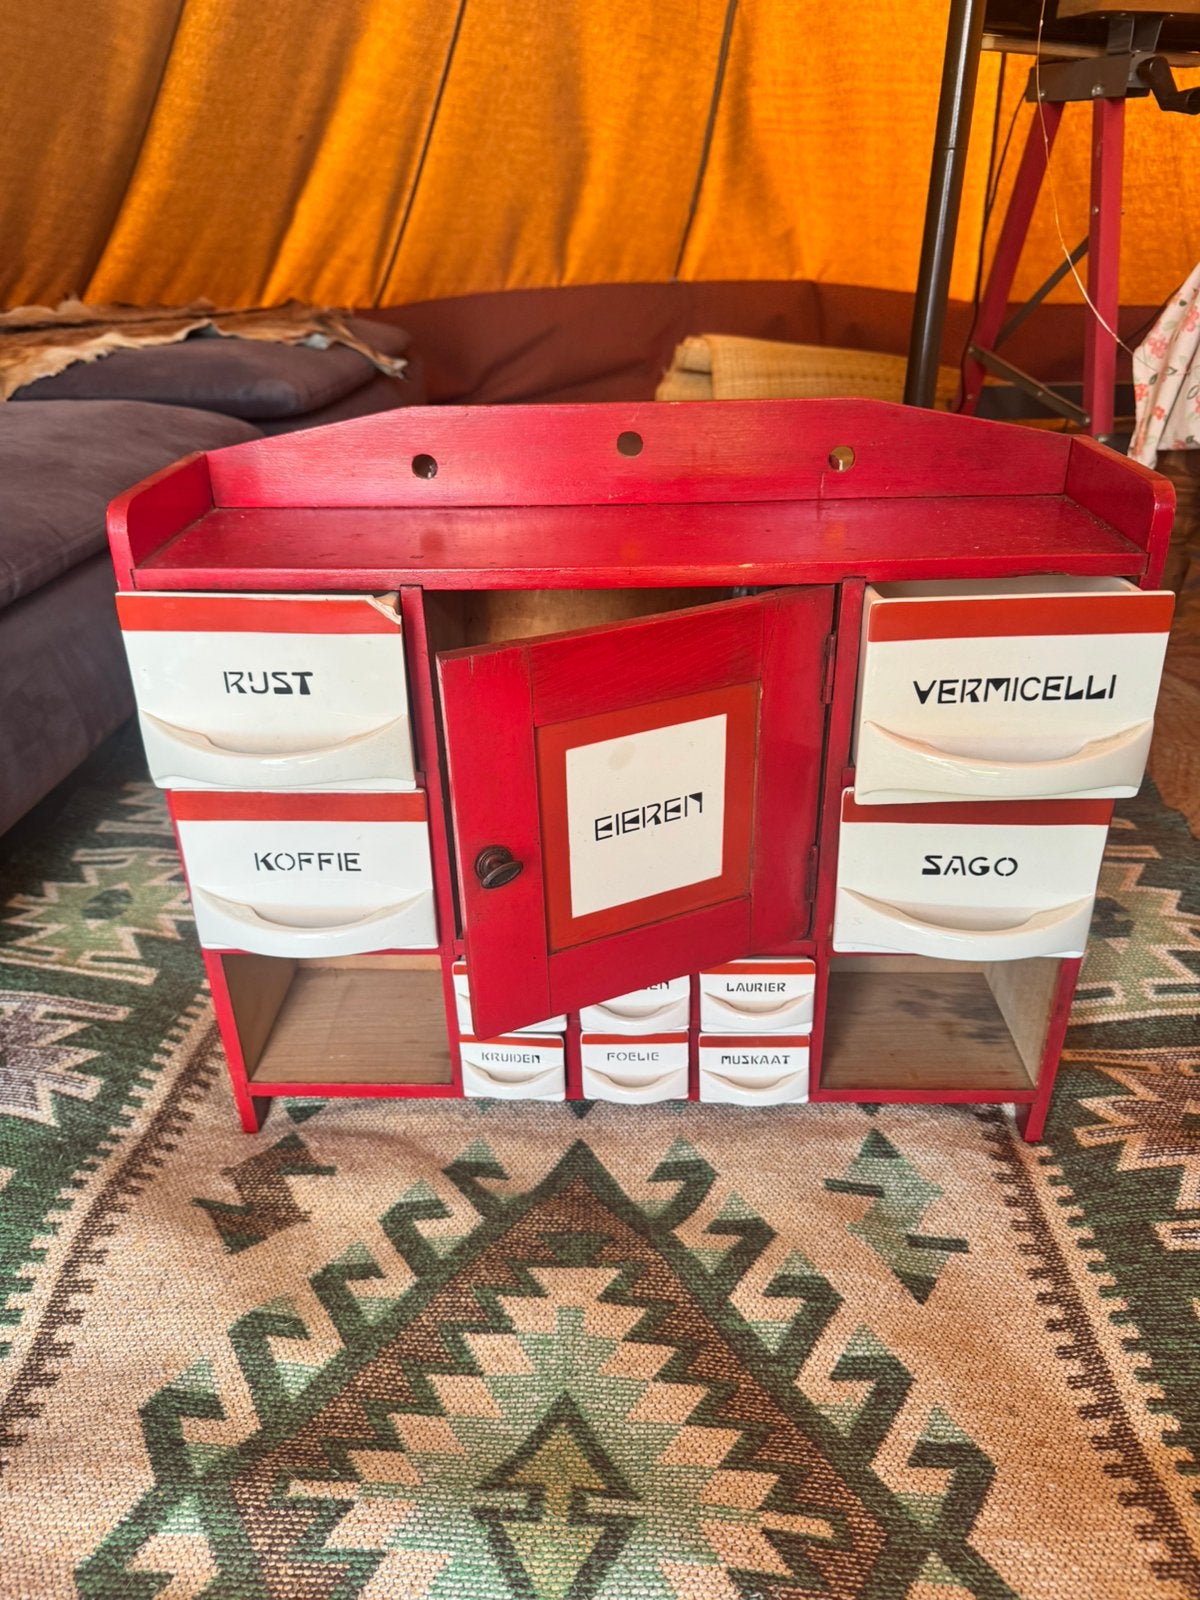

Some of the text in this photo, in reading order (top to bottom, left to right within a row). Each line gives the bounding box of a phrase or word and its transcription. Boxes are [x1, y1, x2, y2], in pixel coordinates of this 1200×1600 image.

[913, 674, 1117, 704] VERMICELLI
[595, 792, 703, 841] EIEREN
[254, 852, 362, 872] KOFFIE
[922, 855, 1018, 877] SAGO
[726, 982, 786, 993] LAURIER
[481, 1052, 541, 1064] KRUIDEN
[607, 1051, 660, 1062] FOELIE
[721, 1054, 791, 1065] MUSKAAT
